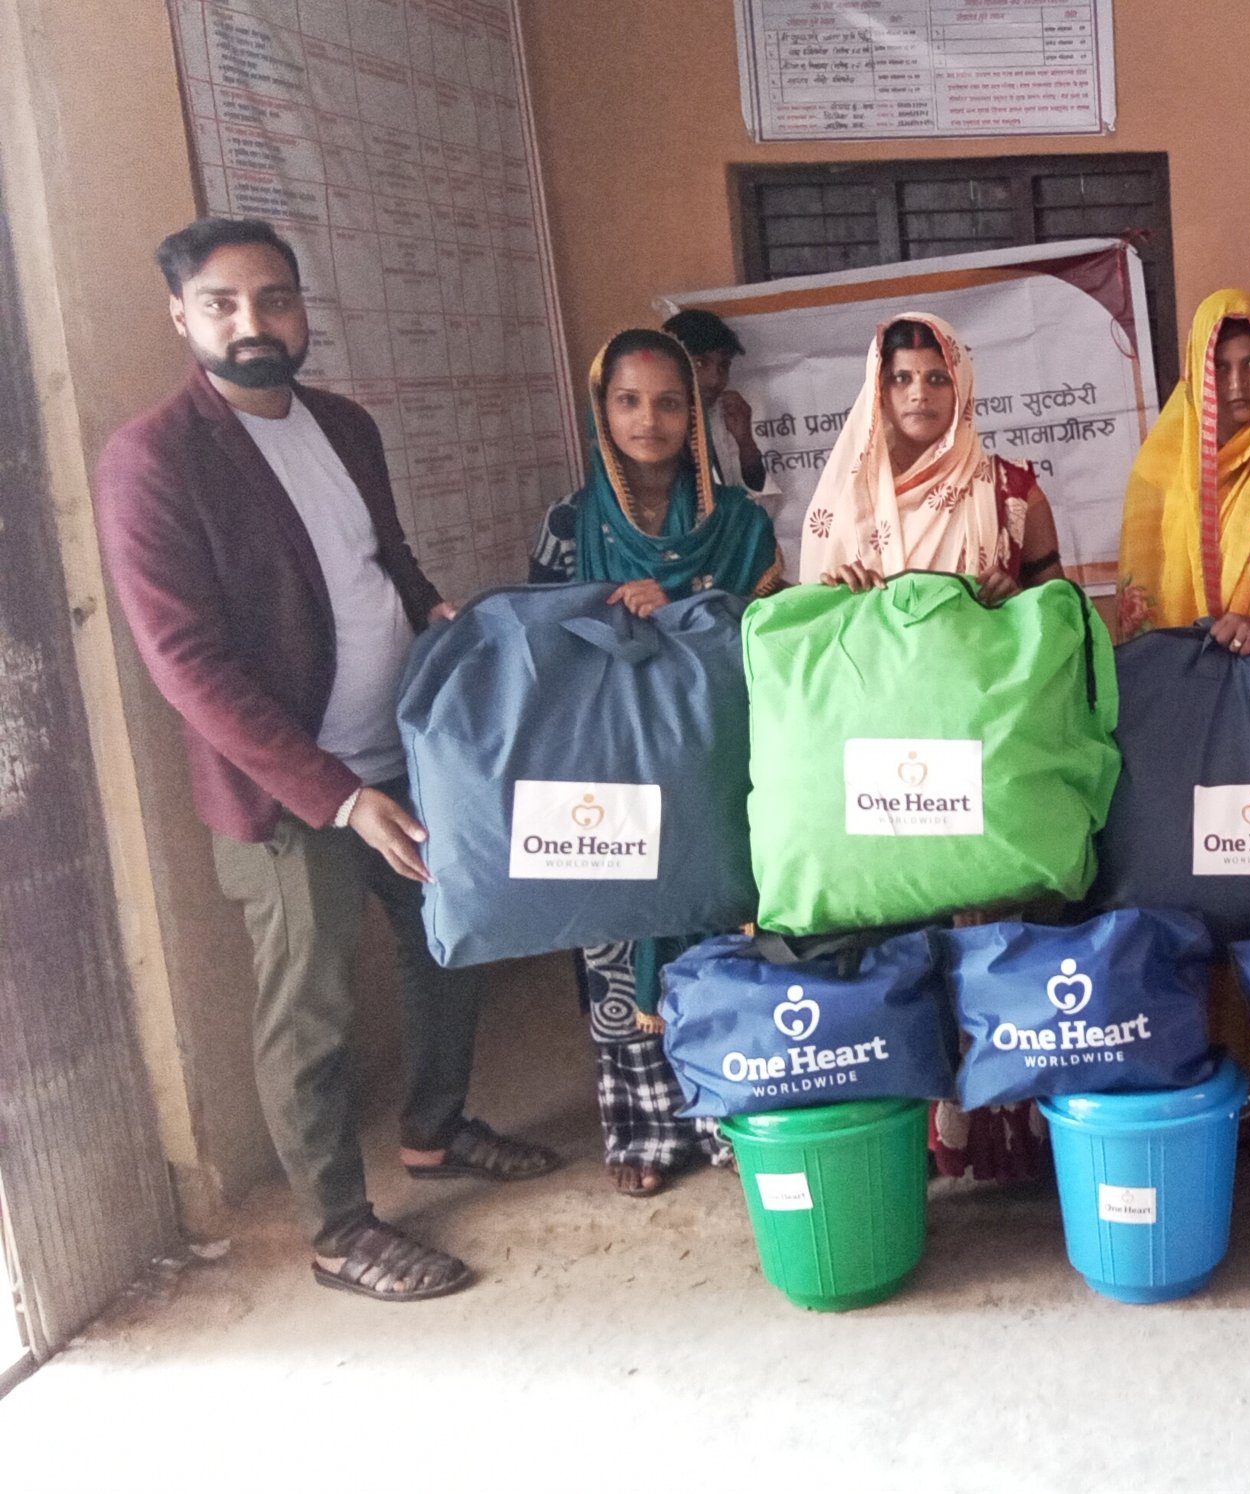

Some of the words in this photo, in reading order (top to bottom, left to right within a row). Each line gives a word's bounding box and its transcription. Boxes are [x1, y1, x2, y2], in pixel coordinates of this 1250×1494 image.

[973, 395, 1013, 417] तथा
[1020, 382, 1097, 417] सुत्केरी
[857, 793, 900, 811] One
[904, 793, 971, 812] Heart
[523, 835, 573, 854] One
[576, 836, 647, 856] Heart
[1204, 833, 1246, 852] One
[992, 1022, 1056, 1051] One
[1058, 1013, 1152, 1050] Heart
[722, 1051, 786, 1082] One
[787, 1035, 889, 1076] Heart
[1024, 1051, 1125, 1068] WORLDWIDE
[752, 1070, 858, 1098] WORLDWIDE
[1124, 1206, 1151, 1214] Heart
